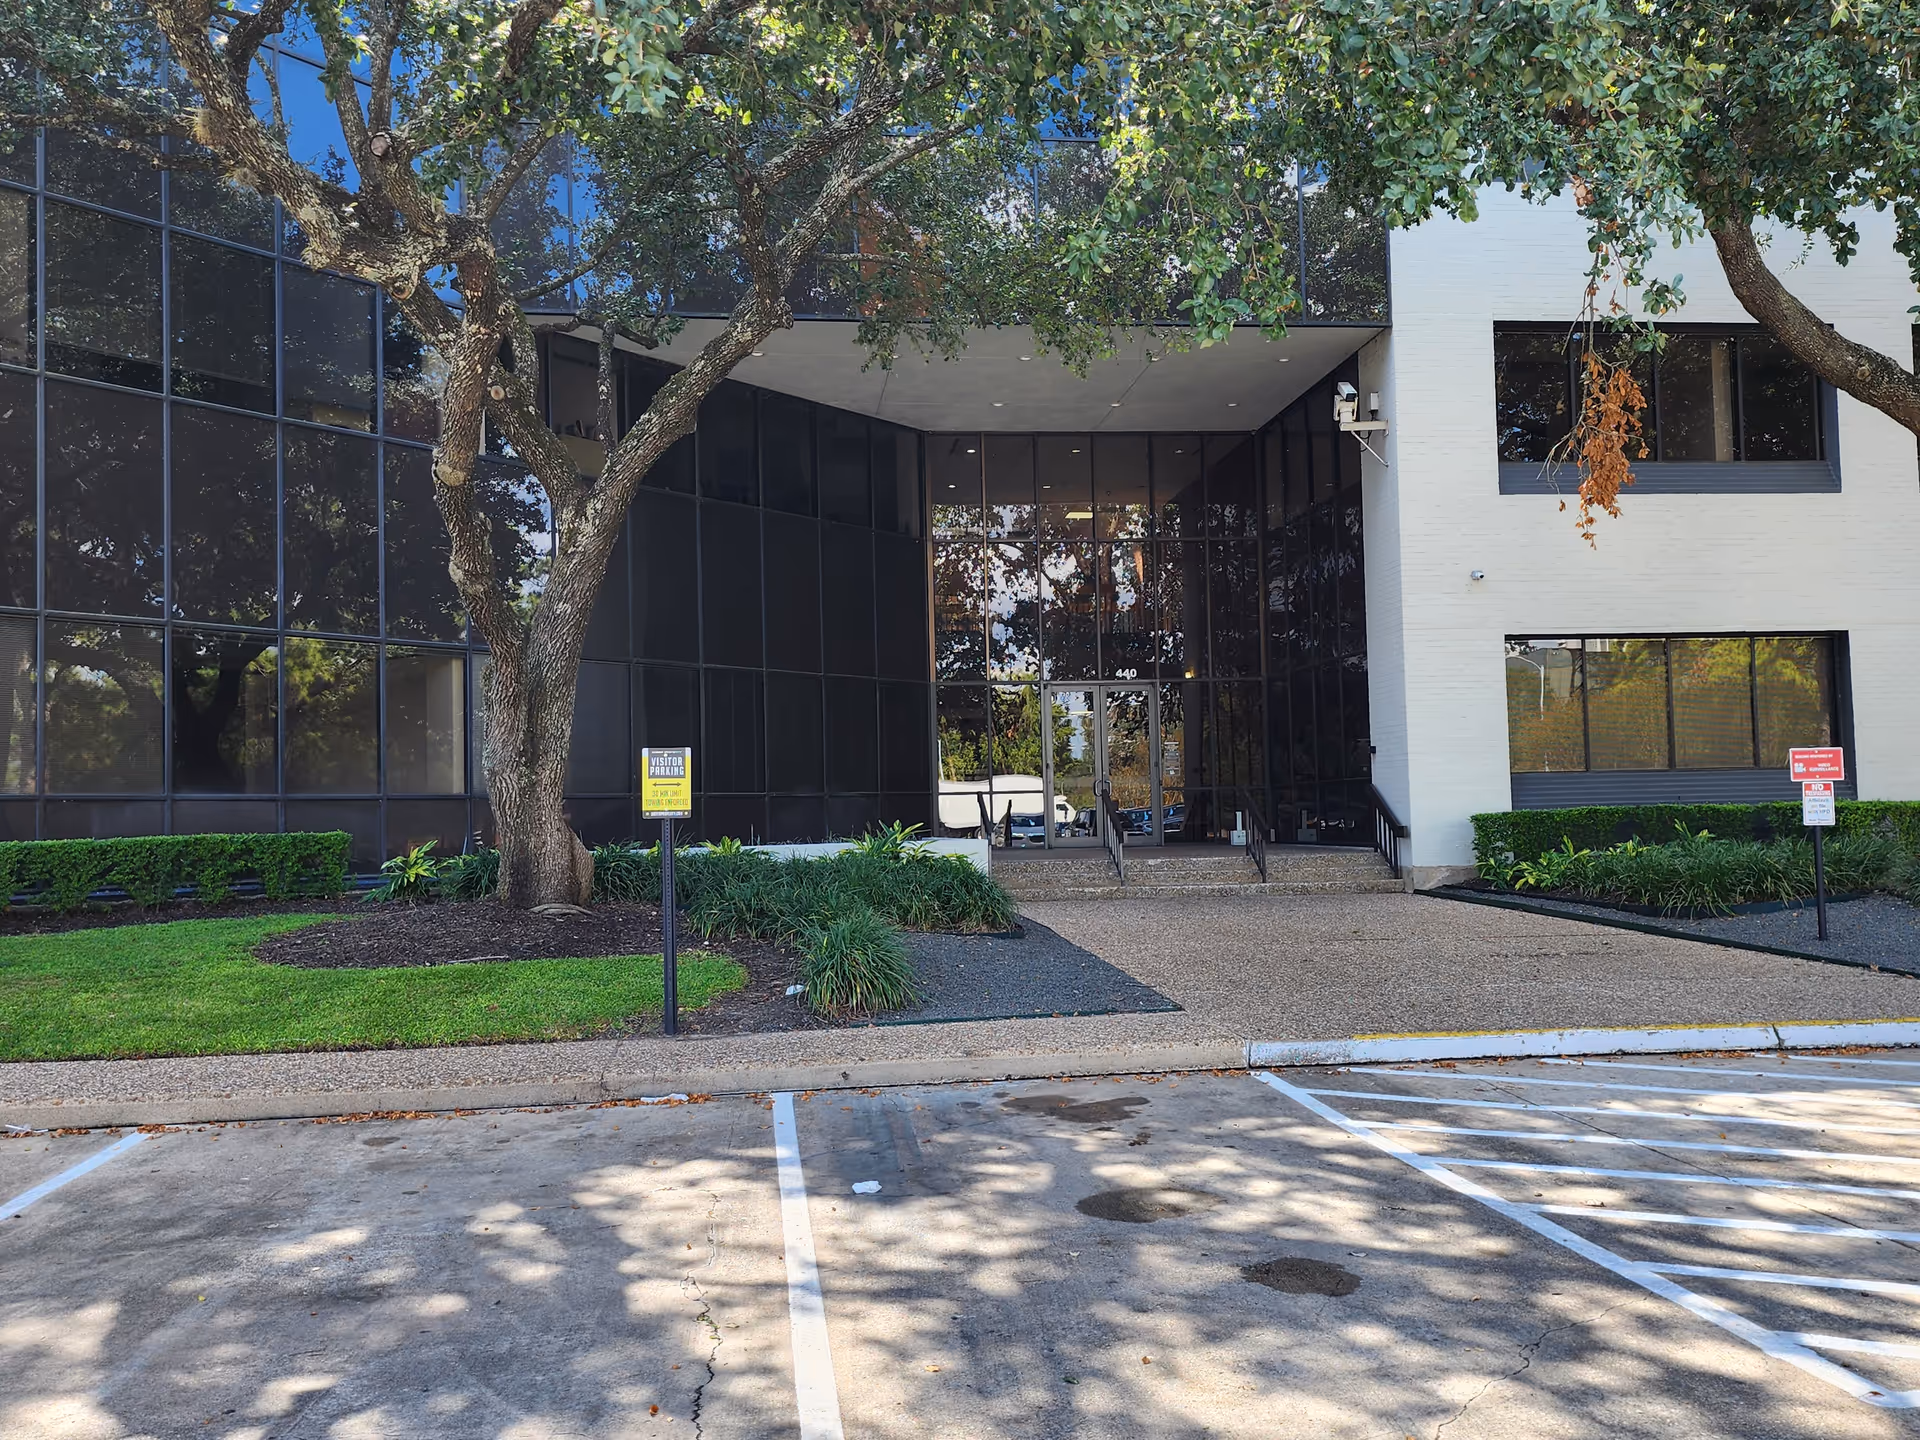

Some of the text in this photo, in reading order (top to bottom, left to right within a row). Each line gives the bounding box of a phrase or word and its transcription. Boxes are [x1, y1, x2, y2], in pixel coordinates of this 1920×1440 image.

[1115, 668, 1137, 678] 440
[651, 757, 683, 766] VISITOR
[650, 767, 684, 775] PARKING
